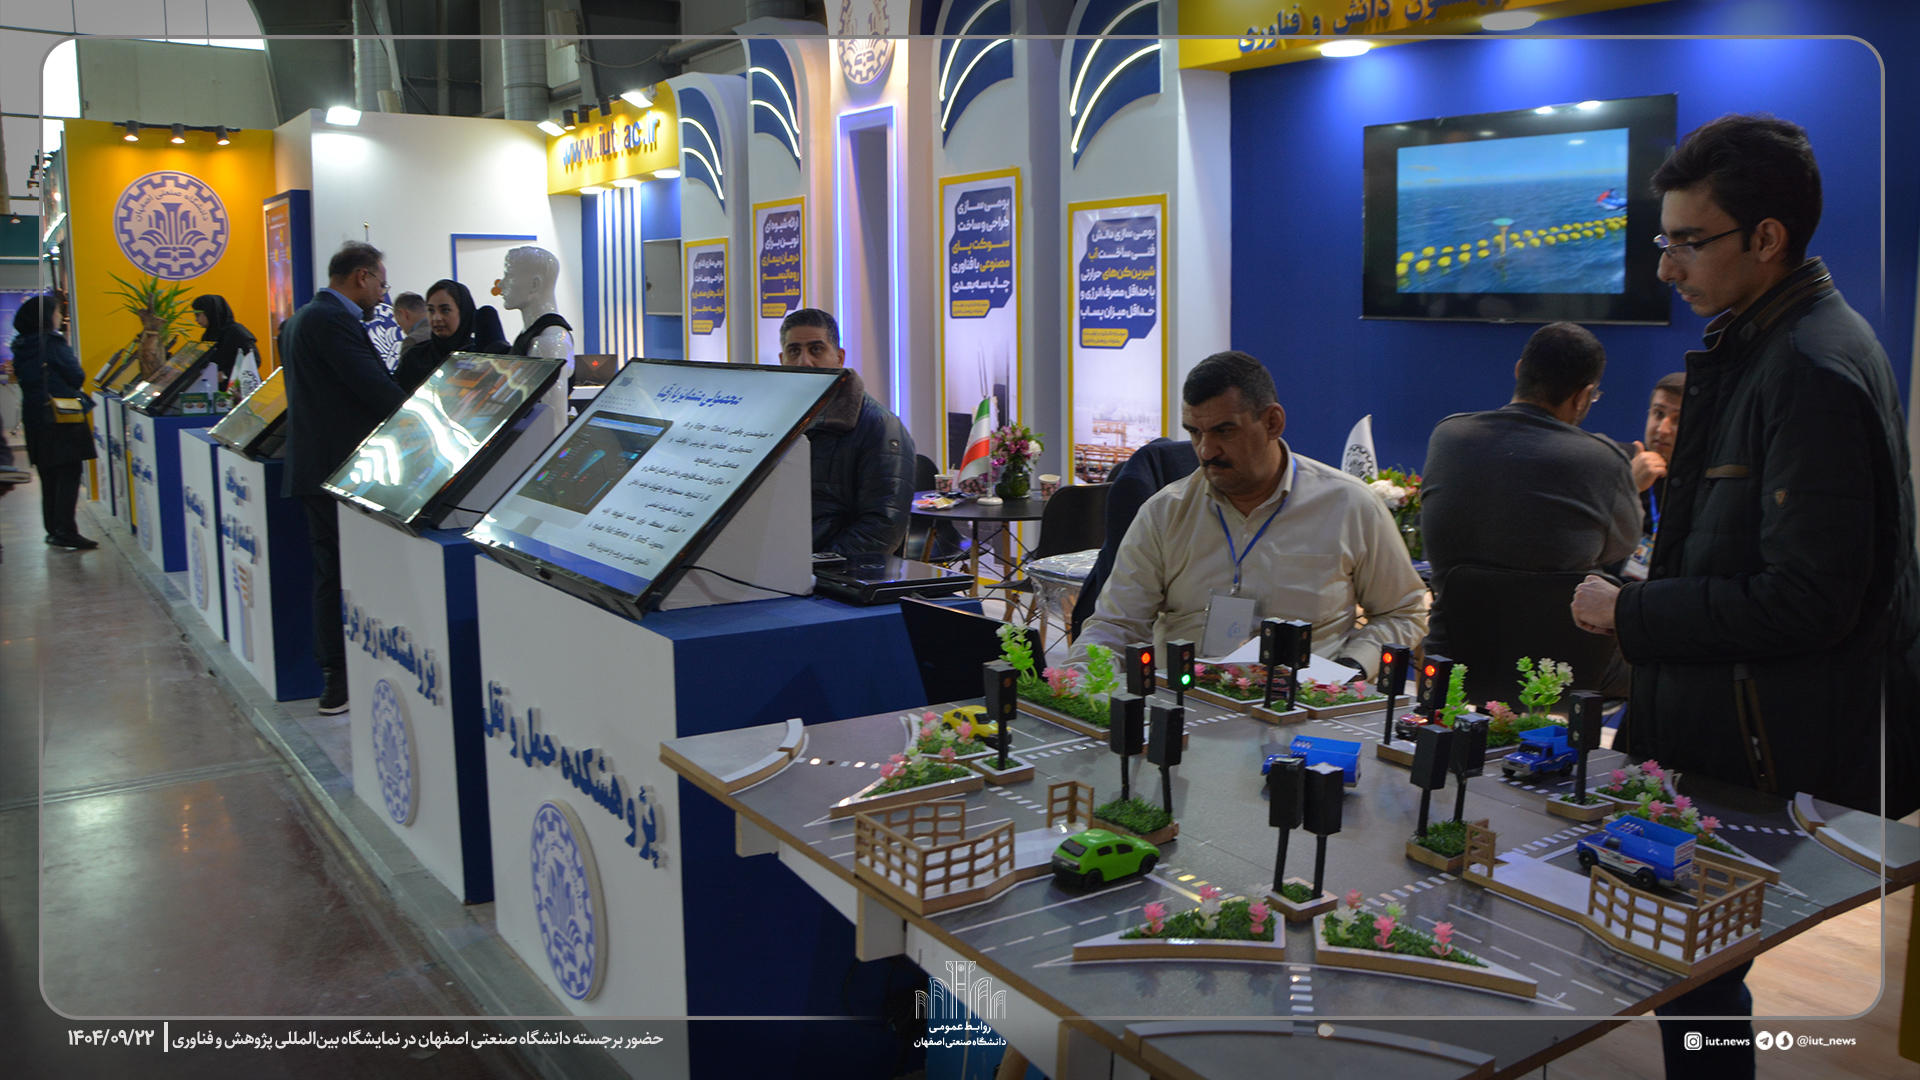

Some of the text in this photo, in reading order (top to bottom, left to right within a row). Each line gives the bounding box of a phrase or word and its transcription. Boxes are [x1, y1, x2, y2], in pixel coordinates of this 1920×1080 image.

[1238, 7, 1301, 53] فناوری
[1311, 13, 1321, 36] و
[563, 110, 659, 166] www.iut.ac.ir
[957, 198, 1010, 215] بومی سازی
[957, 218, 981, 231] ساخت
[986, 219, 1010, 233] طراحی
[765, 235, 799, 250] نوین برای
[1091, 227, 1156, 242] بومی سازی دانش
[951, 237, 1010, 255] سوکت پای
[1088, 243, 1156, 262] فنی ساخت آب
[761, 252, 799, 267] درمان بیماری
[951, 256, 975, 274] فناوری
[980, 257, 1010, 272] مصنوعی
[1081, 268, 1102, 282] حرارتی
[762, 285, 800, 300] مفصلی
[989, 277, 1011, 294] چاپ
[1084, 287, 1103, 300] انرژی
[1103, 284, 1125, 300] مصرف
[1125, 284, 1149, 299] حداقل
[1149, 288, 1156, 300] با
[1080, 303, 1156, 321] حداقل میزان پساب
[655, 383, 743, 407] محصولی متمایز با رقبا
[379, 625, 437, 706] پژوهشکده
[483, 680, 664, 869] پژوهشکده حمل و نقل
